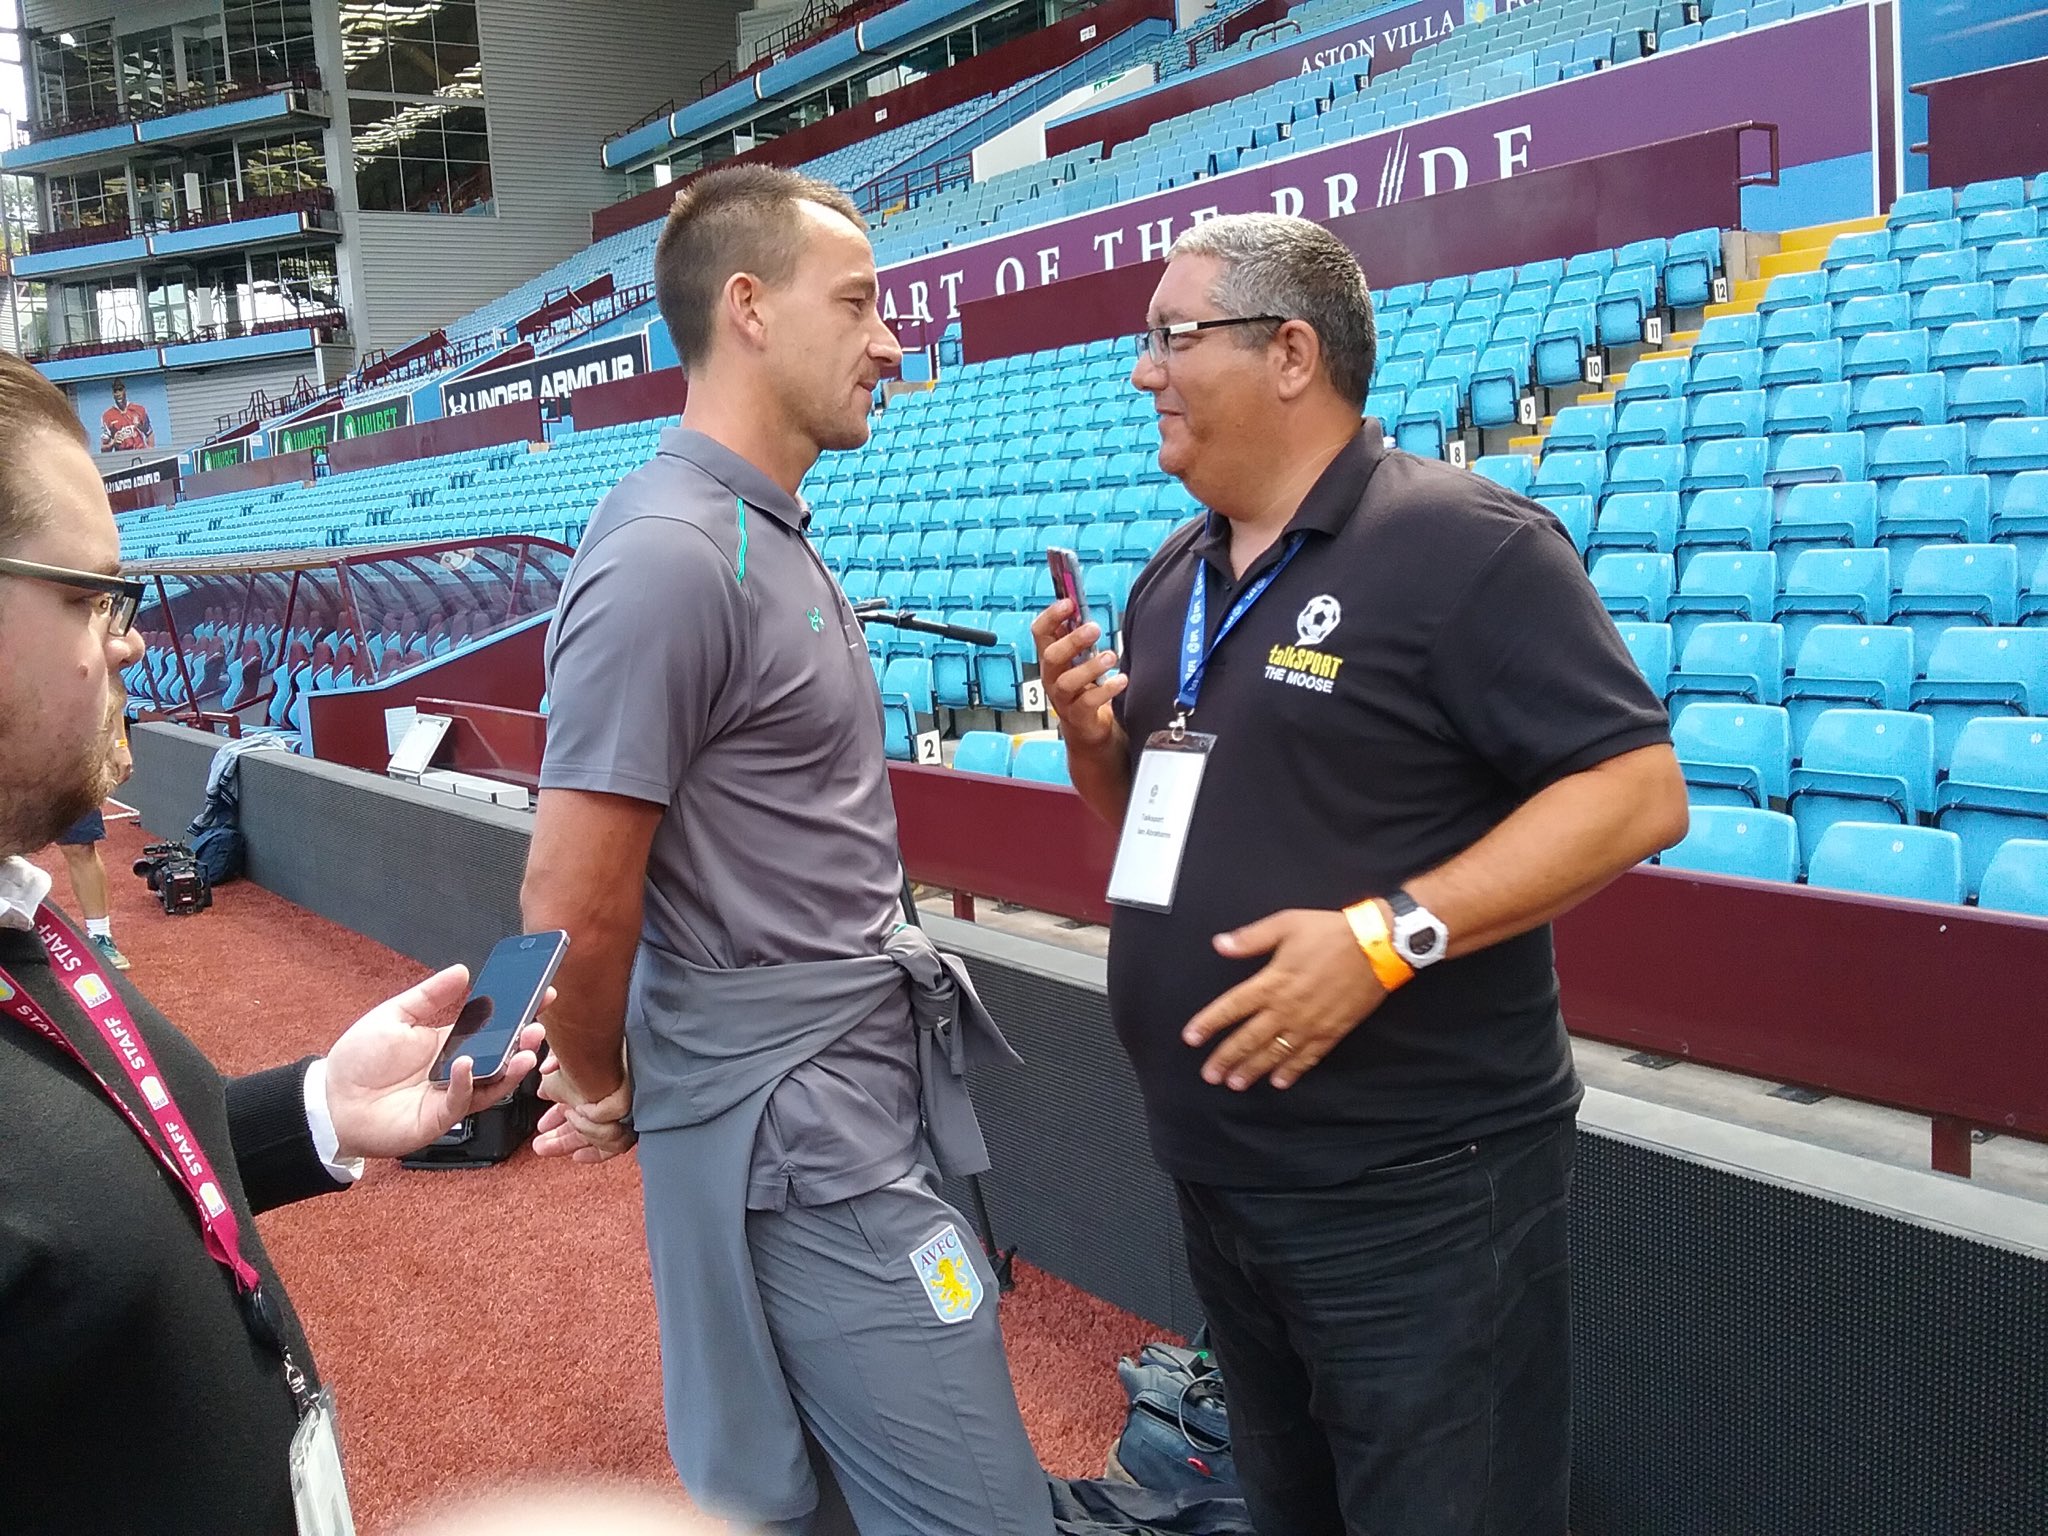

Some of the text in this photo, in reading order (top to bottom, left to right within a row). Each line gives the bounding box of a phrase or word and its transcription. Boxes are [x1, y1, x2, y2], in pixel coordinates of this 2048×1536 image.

[1300, 10, 1457, 75] ASTON VILLA
[996, 246, 1060, 296] OF
[1715, 281, 1728, 298] 12
[1650, 323, 1660, 339] 11
[540, 354, 635, 404] ARMOUR
[1588, 362, 1601, 378] 10
[1523, 403, 1532, 419] 9
[1454, 446, 1462, 464] 8
[1268, 644, 1343, 680] talkSPORT
[1264, 665, 1335, 694] THE MOOSE
[1029, 686, 1039, 706] 3
[924, 738, 935, 759] 2
[38, 922, 82, 972] STAFF
[103, 1016, 146, 1070] STAFF
[165, 1121, 203, 1177] STAFF
[920, 1232, 958, 1271] AVFC
